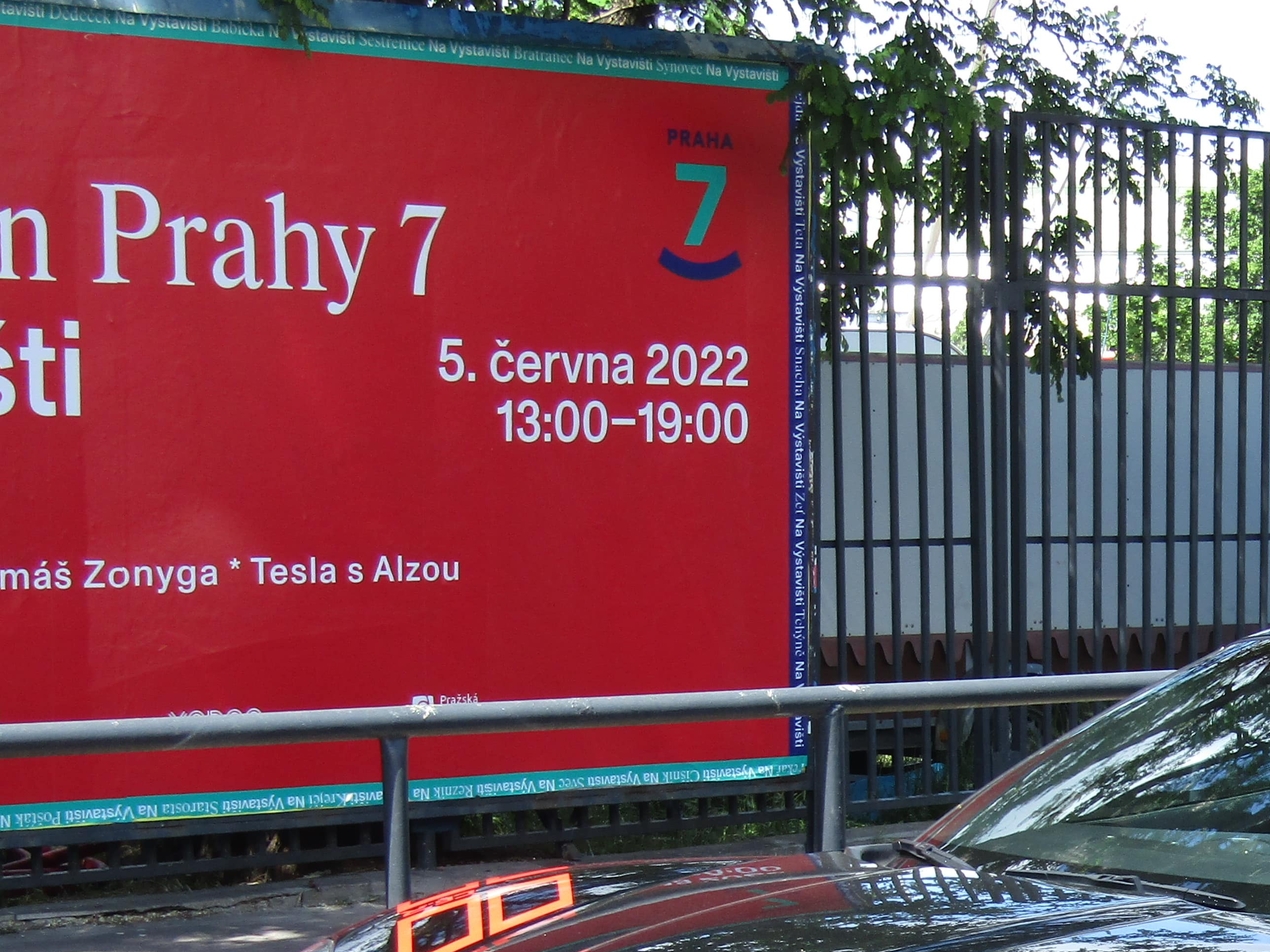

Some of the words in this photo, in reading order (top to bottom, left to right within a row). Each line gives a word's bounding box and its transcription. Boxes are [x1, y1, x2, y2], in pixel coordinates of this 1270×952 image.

[115, 13, 135, 26] Na
[429, 40, 446, 54] Na
[450, 41, 509, 58] Výstavišti
[514, 45, 573, 64] Bratranec
[577, 52, 593, 66] Na
[597, 54, 652, 71] Výstavišti
[656, 58, 703, 76] Synovec
[706, 64, 722, 77] Na
[726, 65, 780, 82] Výstavišti
[667, 128, 734, 150] PRAHA
[795, 149, 806, 215] Výstavišti
[675, 162, 727, 246] 7
[795, 221, 806, 249] Teta
[0, 207, 57, 282] n
[90, 183, 377, 315] Prahy
[400, 204, 447, 296] 7
[795, 254, 805, 272] Na
[793, 277, 805, 342] Výstavišti
[438, 338, 476, 382] 5.
[490, 339, 634, 384] června
[645, 343, 749, 387] 2022
[794, 346, 805, 396] Snacha
[795, 401, 805, 419] Na
[497, 399, 749, 444] 13:00–19:00
[793, 424, 805, 488] Výstavišti
[794, 492, 806, 514] Zeť
[795, 519, 805, 537] Na
[84, 559, 218, 594] Zonyga
[250, 556, 336, 585] Tesla
[348, 562, 364, 583] s
[373, 555, 460, 583] Alzou
[793, 541, 805, 605] Výstavišti
[793, 609, 805, 657] Tchýně
[795, 661, 805, 679] Na
[477, 777, 535, 796] Výstavišti
[538, 779, 556, 792] Na
[643, 771, 659, 783] Na
[222, 794, 284, 813] Výstavišti
[287, 795, 305, 809] Na
[413, 787, 430, 800] Na
[65, 804, 135, 824] Výstavišti
[138, 804, 158, 818] Na
[162, 800, 219, 816] Starosta
[0, 814, 11, 829] N
